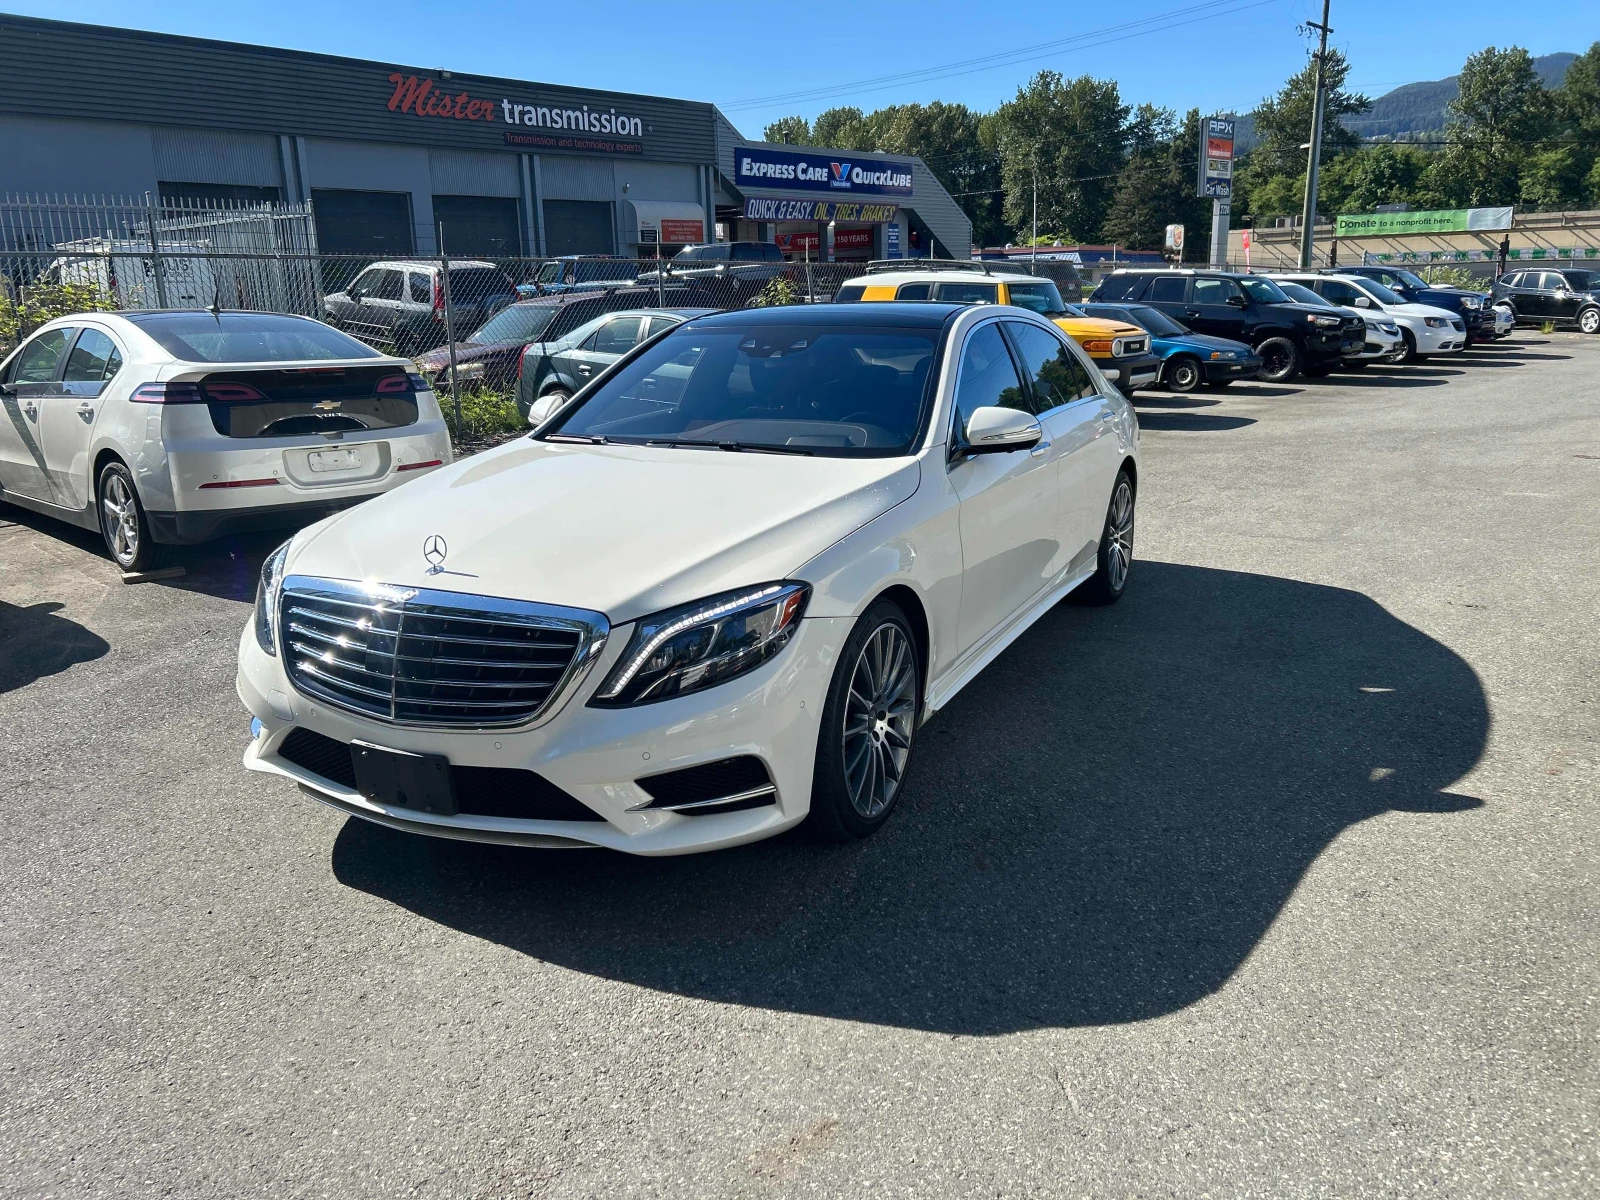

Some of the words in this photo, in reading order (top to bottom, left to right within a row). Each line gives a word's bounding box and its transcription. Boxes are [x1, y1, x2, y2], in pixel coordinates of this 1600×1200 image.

[387, 72, 495, 121] Mister
[501, 98, 643, 137] transmission
[1209, 120, 1233, 133] APX
[505, 132, 556, 147] Transmission
[558, 137, 572, 147] and
[574, 139, 615, 152] technology
[615, 143, 642, 153] experts
[741, 157, 795, 179] EXPRESS
[796, 163, 828, 181] CARE
[1205, 183, 1215, 195] Car
[1215, 184, 1230, 196] Wash
[747, 199, 778, 220] QUICK
[778, 201, 787, 219] &
[787, 202, 813, 220] EASY.
[814, 202, 830, 220] OIL.
[833, 203, 859, 221] TIRES.
[1339, 219, 1377, 229] Donate
[1396, 218, 1432, 227] nonprofit
[1433, 217, 1454, 225] here.
[849, 234, 869, 242] YEARS
